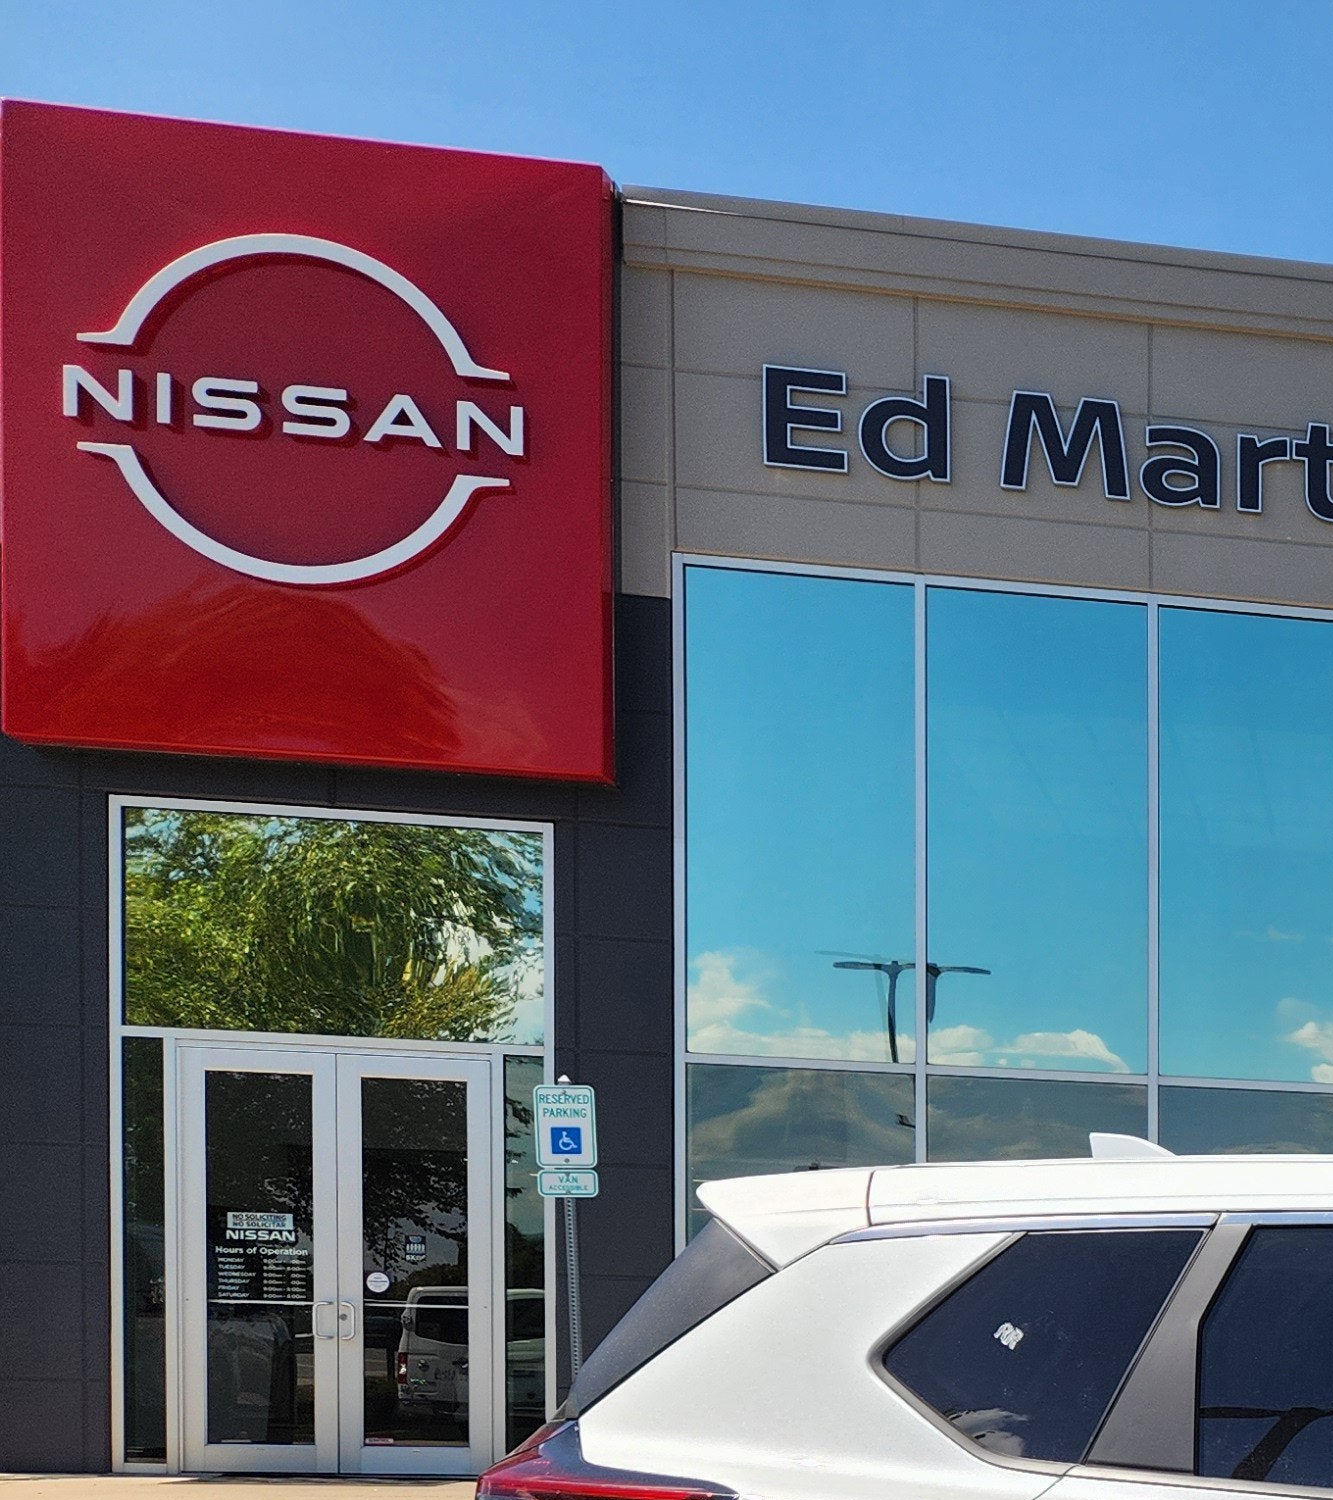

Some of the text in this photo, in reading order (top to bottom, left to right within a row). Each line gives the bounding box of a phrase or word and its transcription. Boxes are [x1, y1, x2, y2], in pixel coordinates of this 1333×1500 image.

[62, 364, 524, 456] NISSAN
[762, 364, 951, 483] Ed
[538, 1093, 589, 1104] RESERVED
[543, 1108, 587, 1118] PARKING
[558, 1176, 578, 1184] VAN
[226, 1229, 295, 1241] NISSAN
[215, 1246, 308, 1256] Hours of Operation
